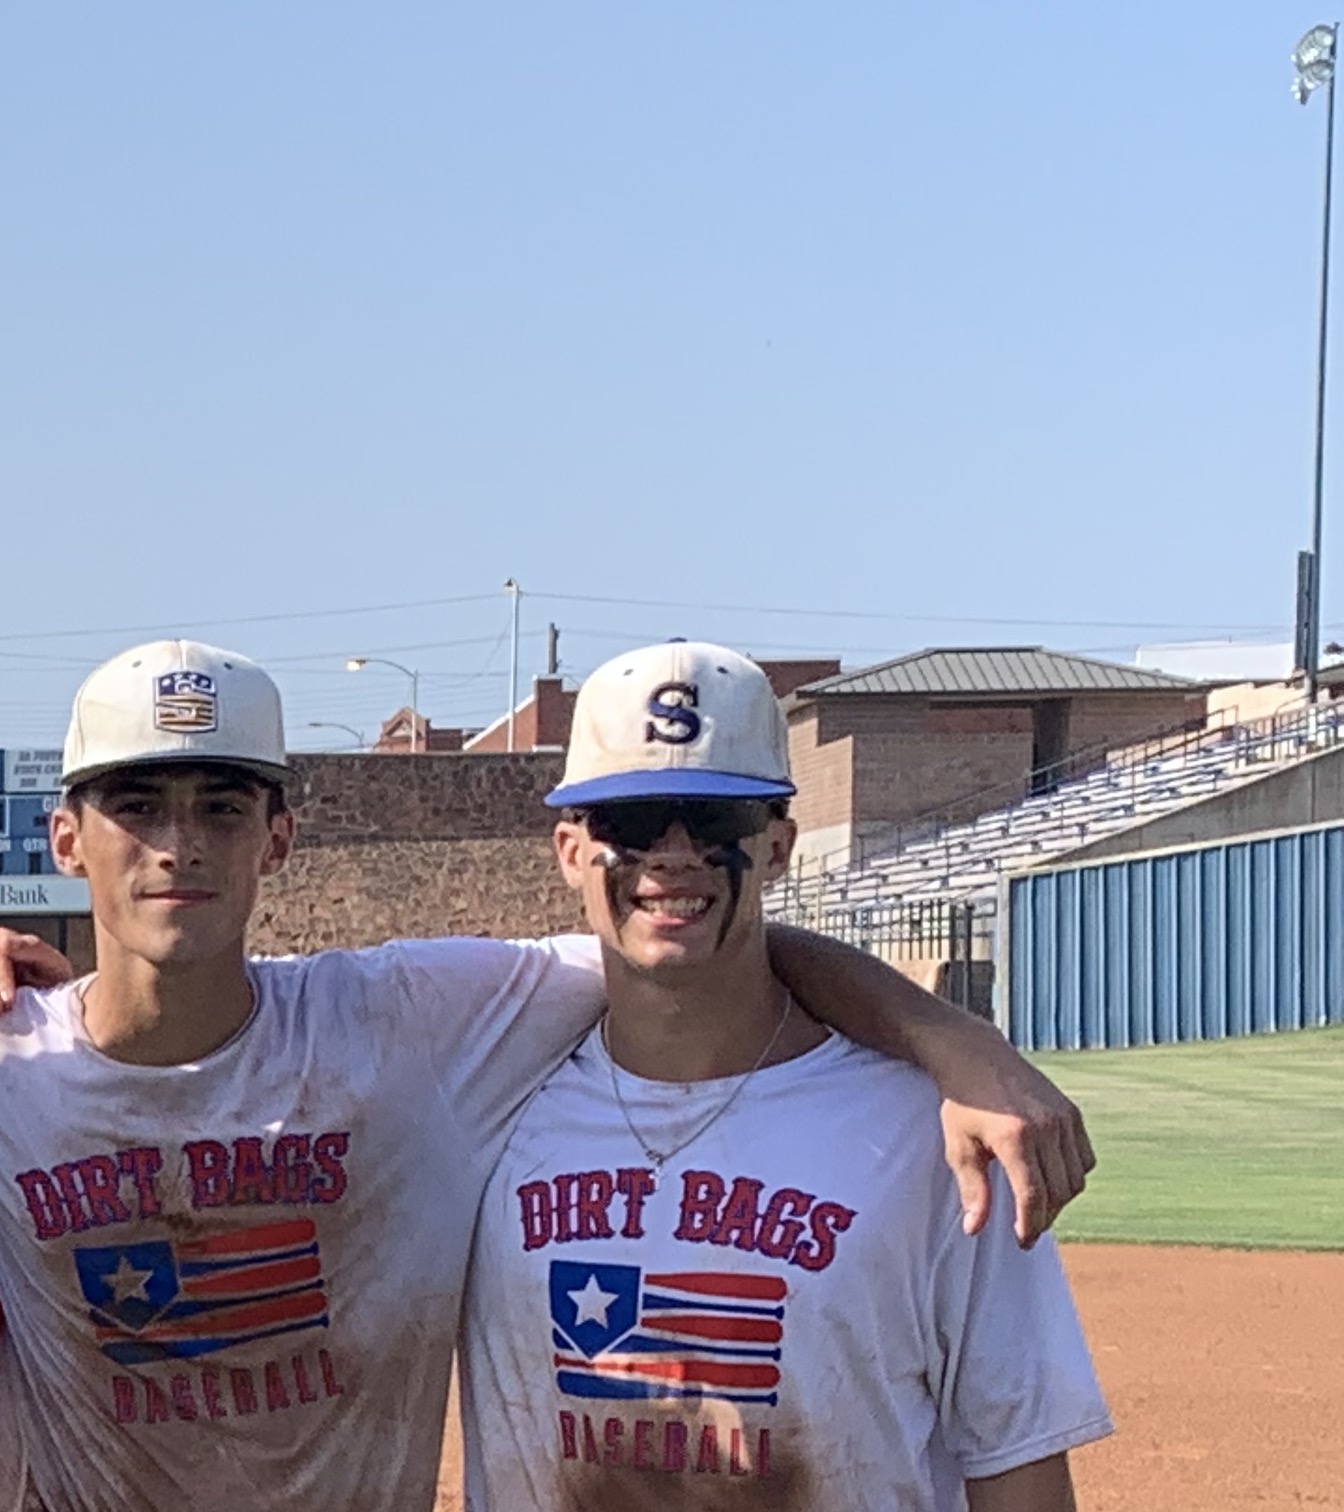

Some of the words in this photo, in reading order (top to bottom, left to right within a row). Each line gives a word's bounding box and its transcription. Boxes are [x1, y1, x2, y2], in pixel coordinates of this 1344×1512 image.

[645, 681, 701, 744] S
[0, 883, 49, 906] Bank
[15, 1146, 162, 1241] DIRT
[182, 1131, 351, 1209] BAGS
[517, 1167, 656, 1252] DIRT
[674, 1169, 858, 1273] BAGS
[112, 1349, 345, 1425] BASEBALL
